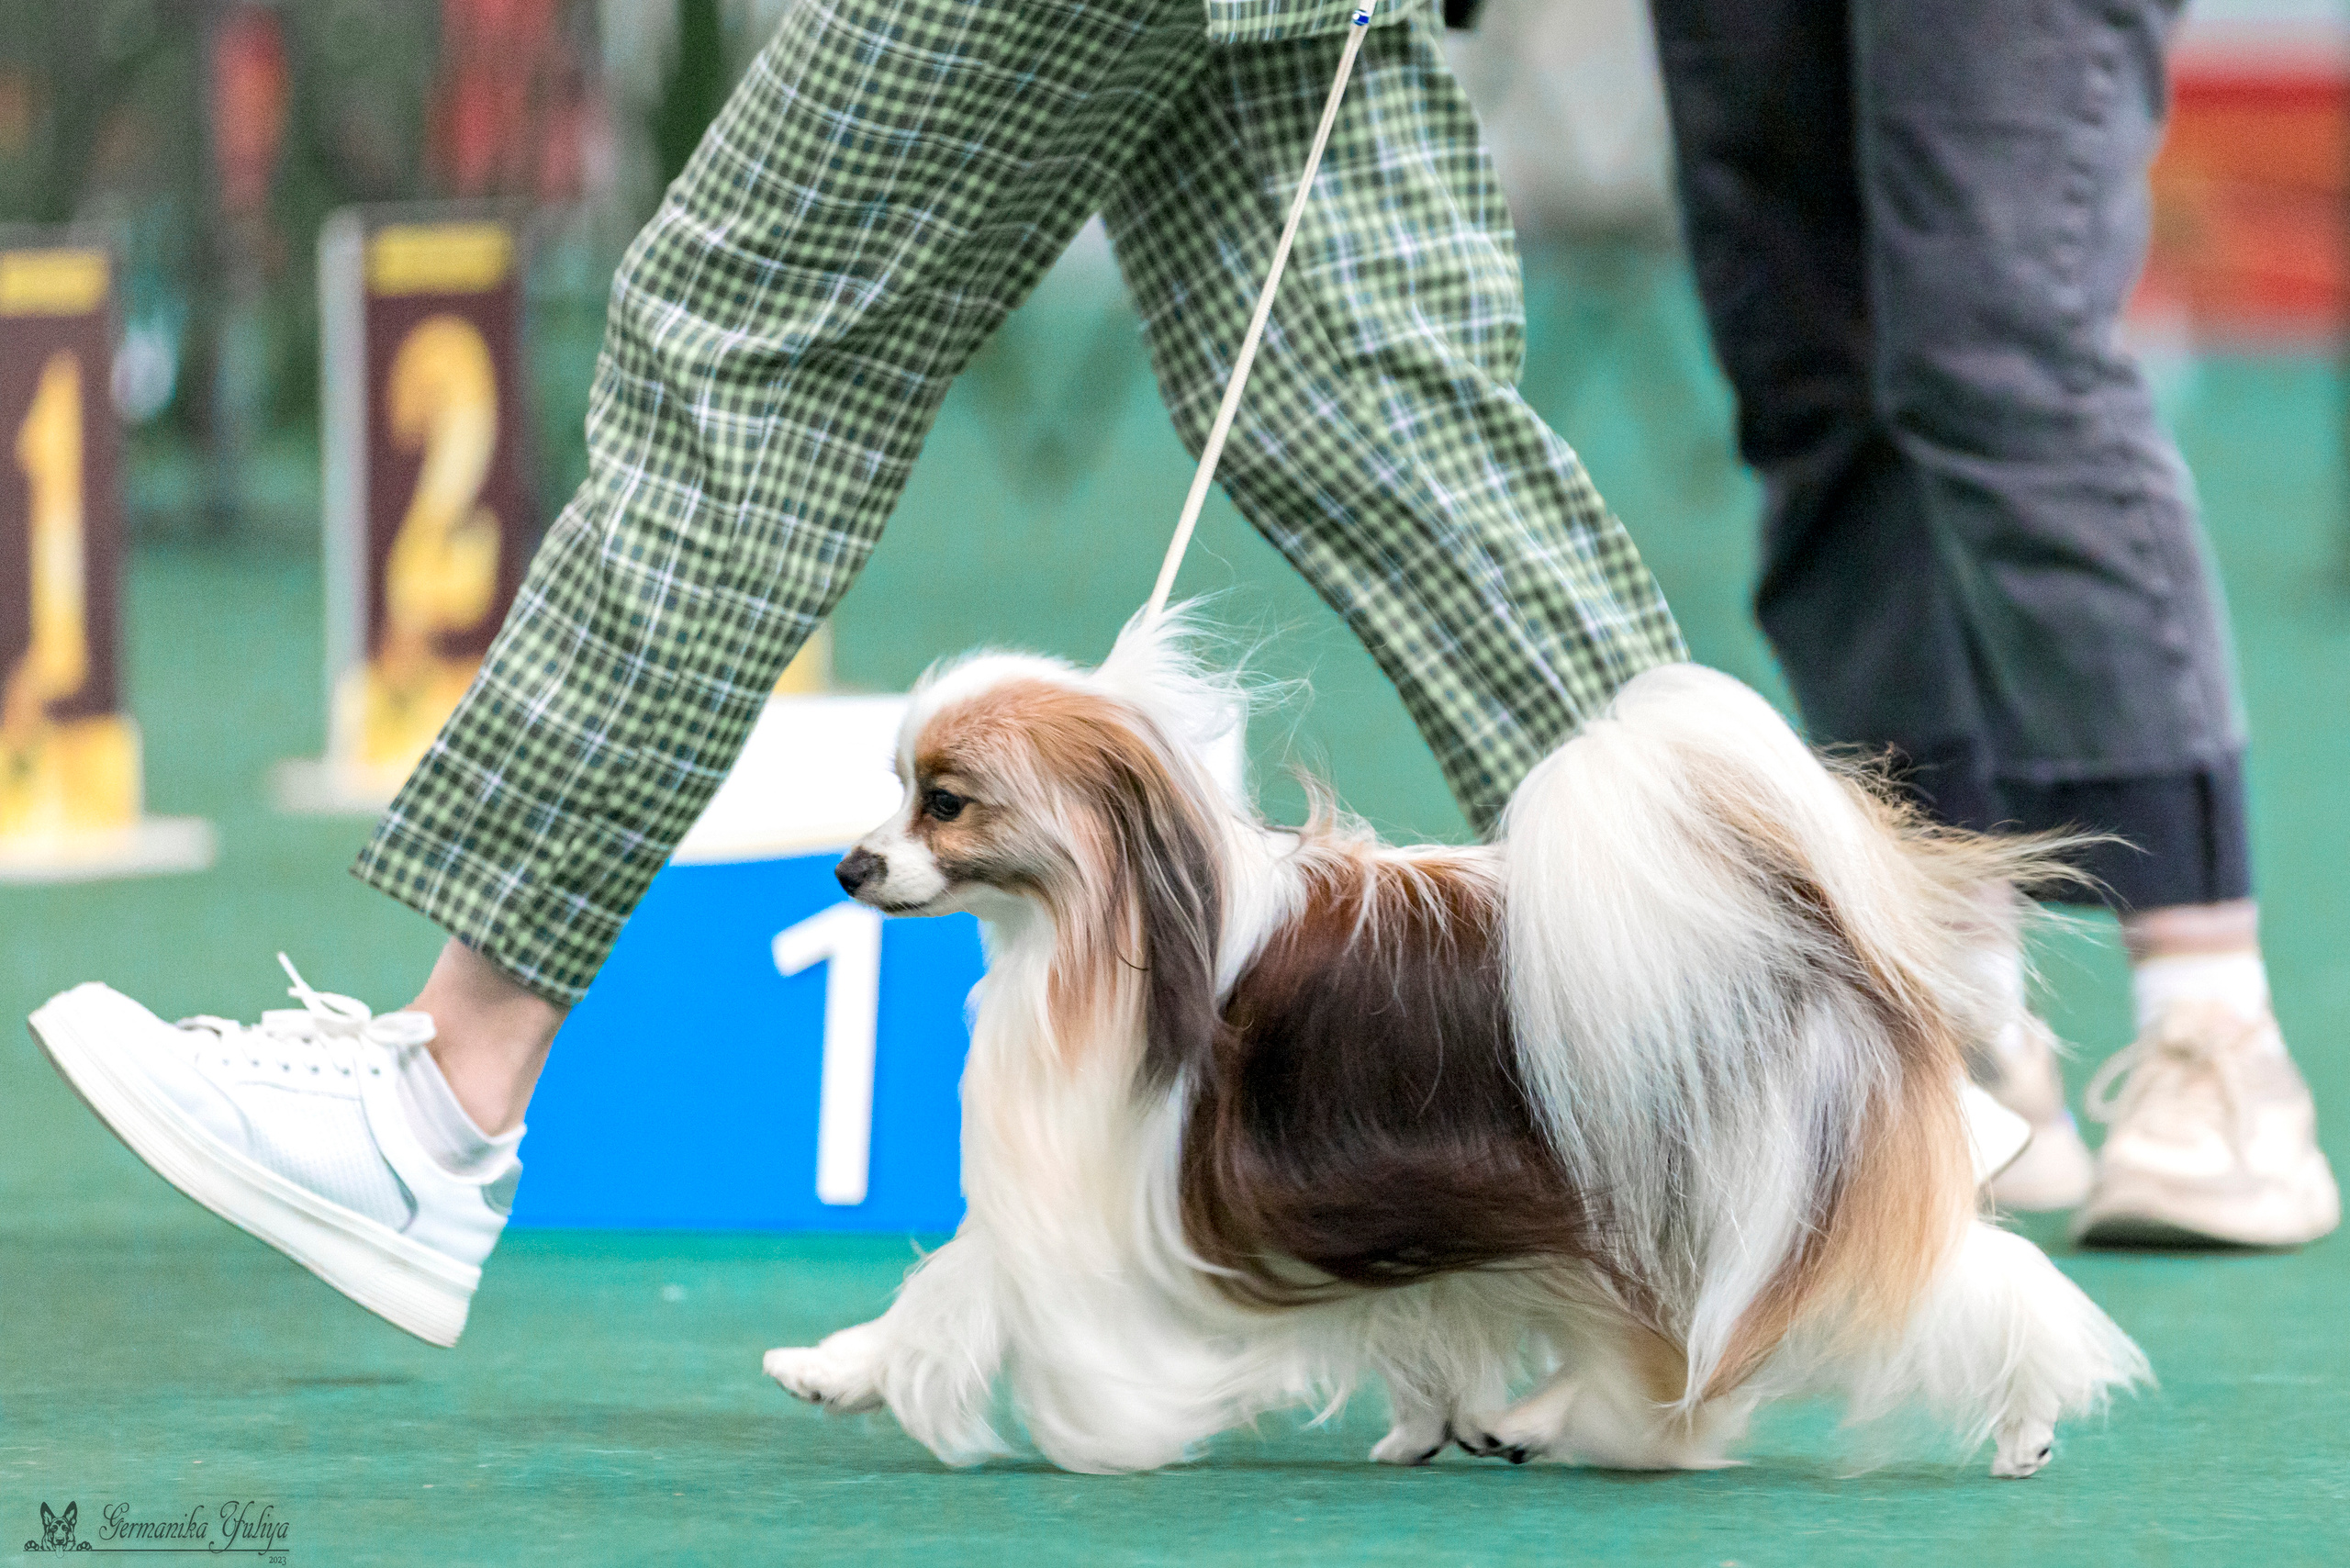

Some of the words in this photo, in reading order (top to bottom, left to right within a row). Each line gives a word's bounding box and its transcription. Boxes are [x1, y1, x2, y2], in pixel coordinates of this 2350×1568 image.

[14, 348, 88, 700] 1
[385, 314, 502, 632] 2
[771, 899, 883, 1206] 1
